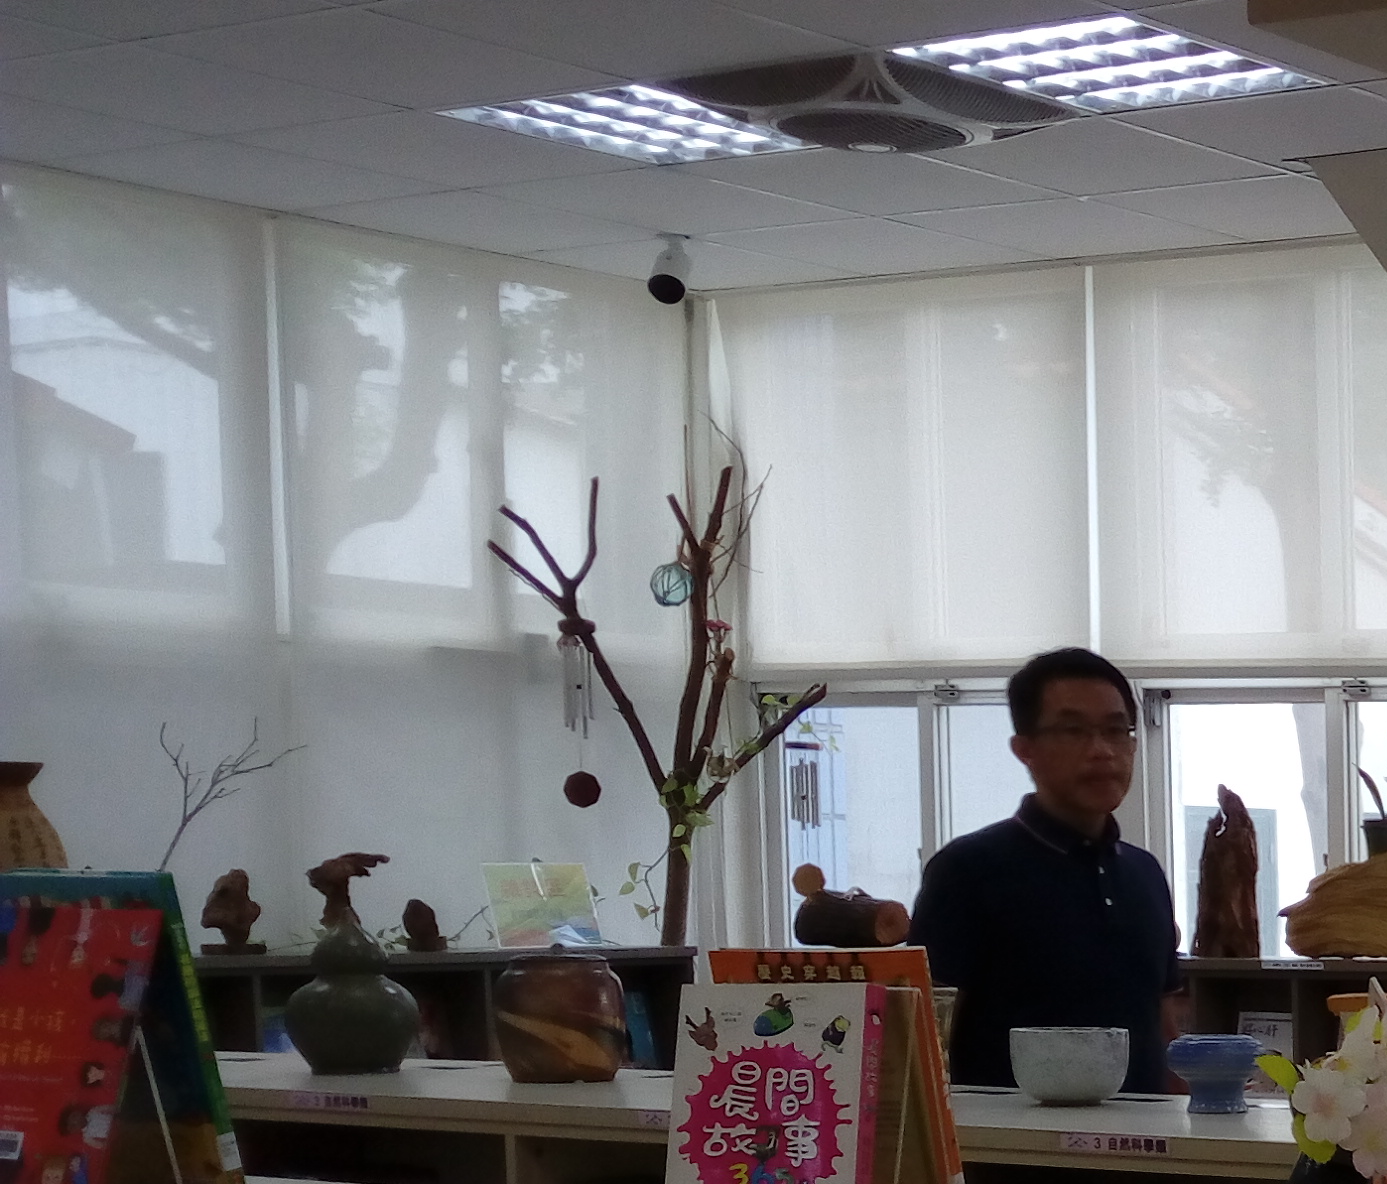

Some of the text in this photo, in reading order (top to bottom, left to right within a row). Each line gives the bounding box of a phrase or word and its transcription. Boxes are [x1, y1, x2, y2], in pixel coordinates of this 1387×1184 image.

[710, 1060, 815, 1121] 晨間
[702, 1114, 821, 1167] 故事
[1108, 1137, 1167, 1153] 自然科學類
